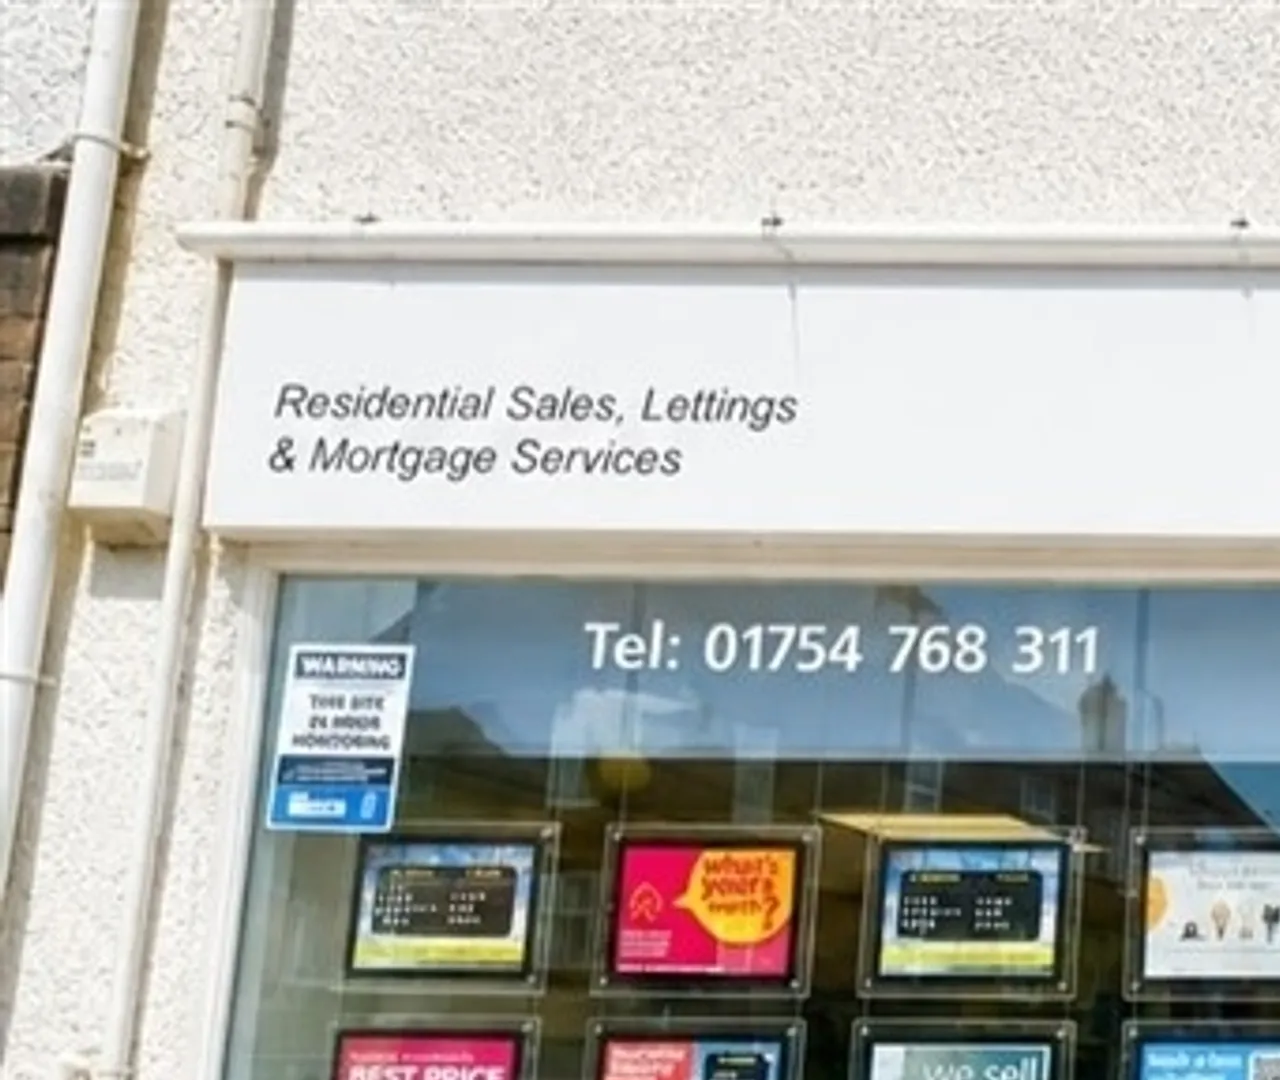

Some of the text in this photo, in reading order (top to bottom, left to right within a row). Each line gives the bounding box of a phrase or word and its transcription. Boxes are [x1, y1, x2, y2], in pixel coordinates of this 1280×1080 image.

[274, 384, 798, 432] Residential Sales, Lettings
[269, 437, 682, 482] & Mortgage Services
[302, 656, 401, 676] WARNING
[584, 620, 1097, 674] Tel: 01754 768 311
